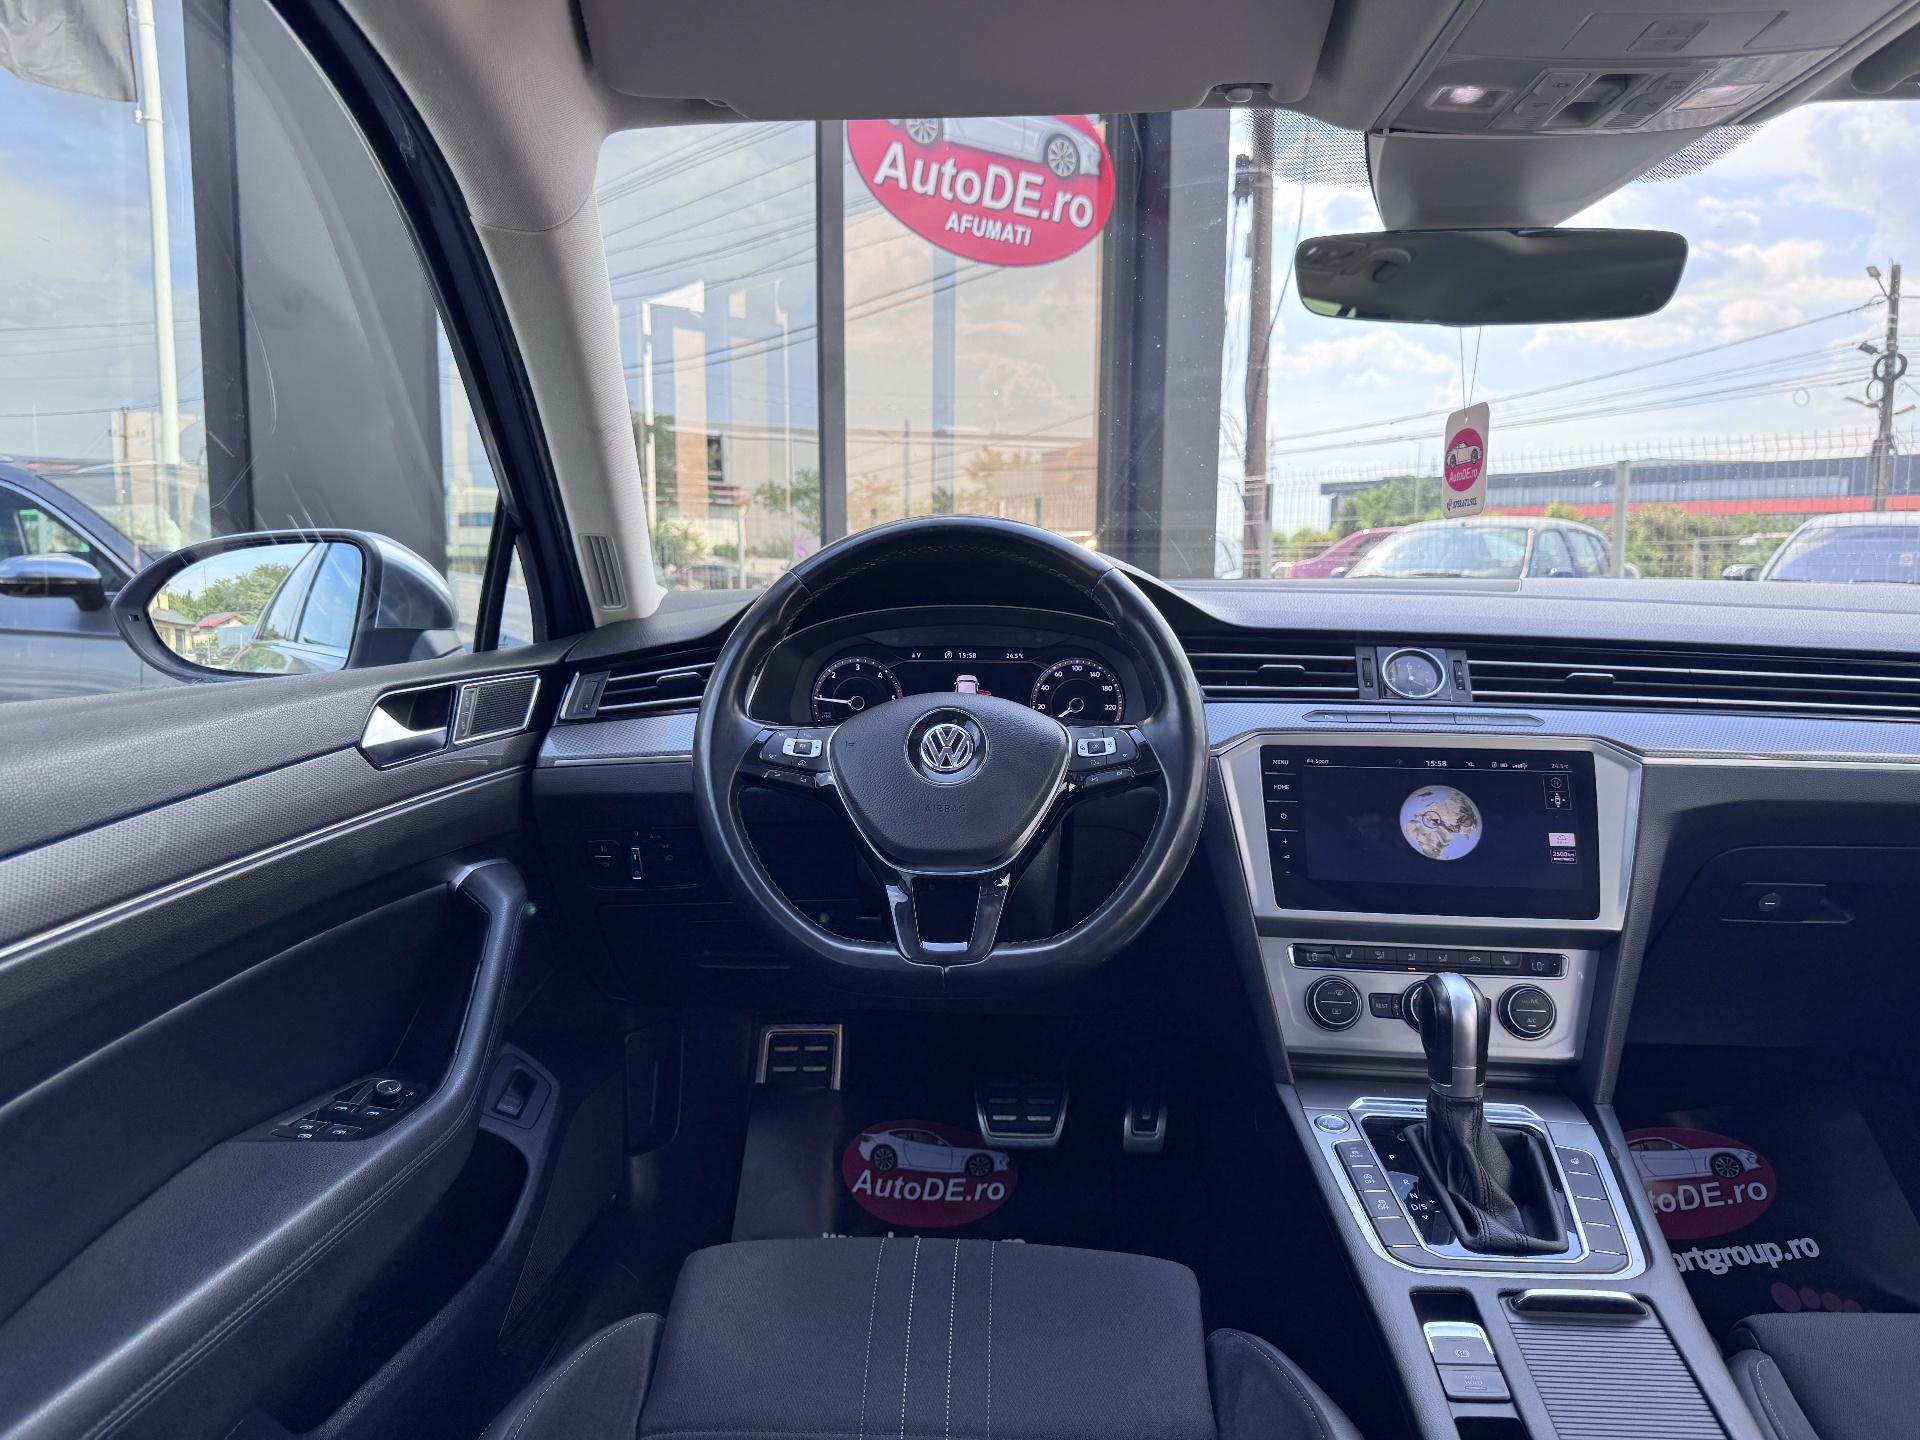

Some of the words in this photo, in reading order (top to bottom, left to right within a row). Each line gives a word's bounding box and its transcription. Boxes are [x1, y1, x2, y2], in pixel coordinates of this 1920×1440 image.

[873, 141, 1093, 228] AutoDE.ro
[944, 212, 1032, 247] AFUMATI
[851, 1169, 1006, 1202] AutoDE.ro
[1647, 1181, 1768, 1214] toDE.ro
[1410, 1203, 1428, 1211] D/S
